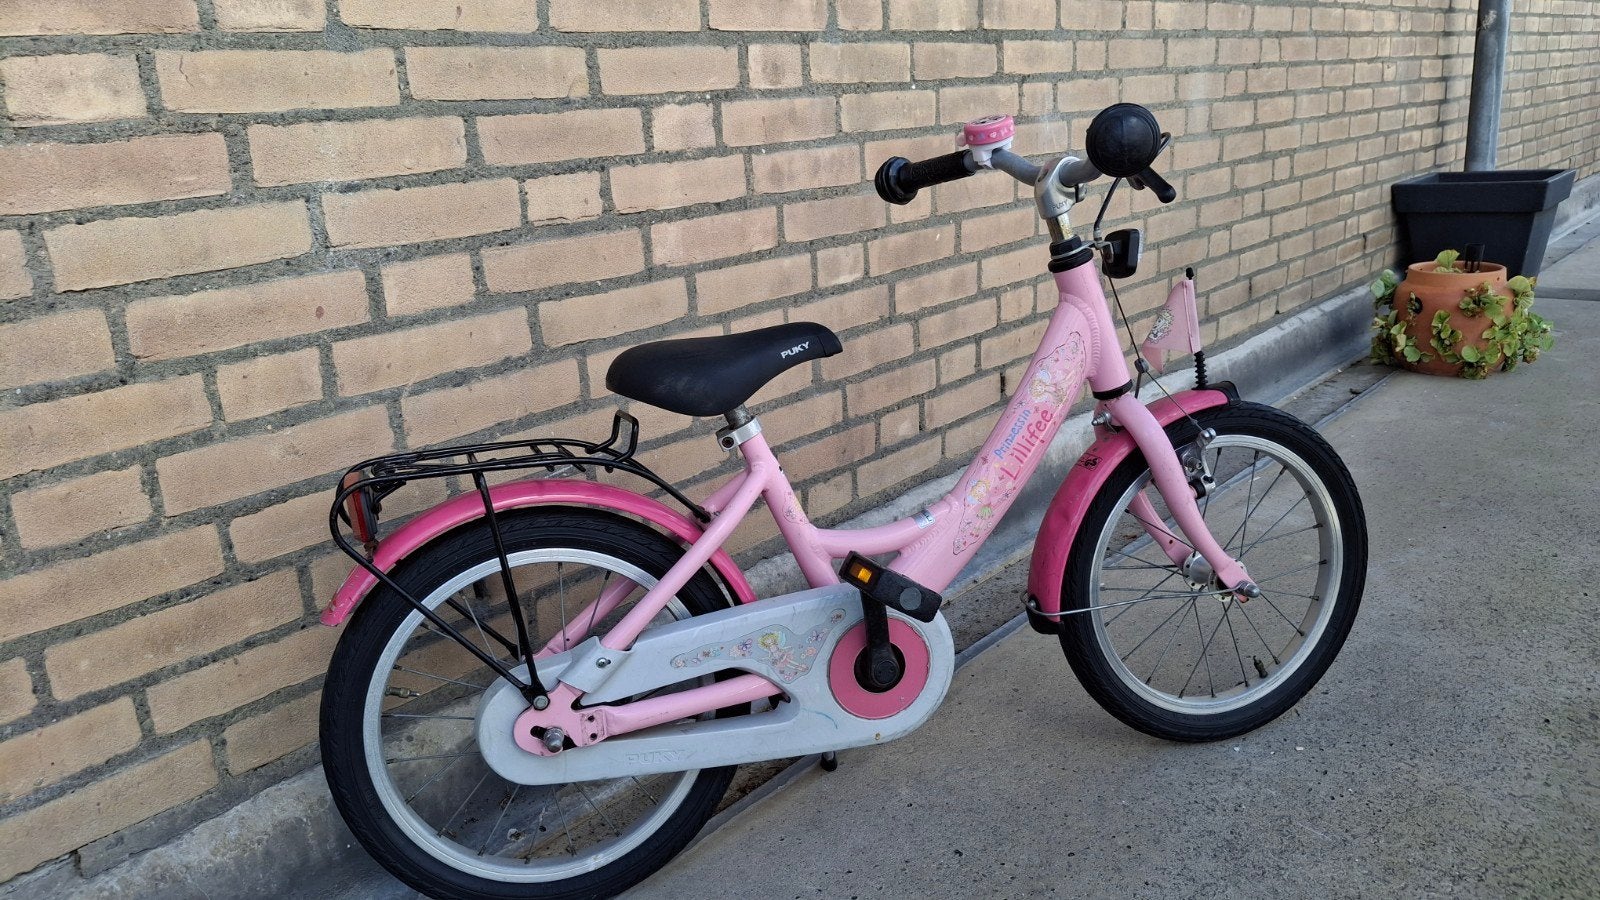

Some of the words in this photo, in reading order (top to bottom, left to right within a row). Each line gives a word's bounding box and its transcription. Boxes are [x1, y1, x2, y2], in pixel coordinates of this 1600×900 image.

[780, 341, 809, 359] PUKY
[993, 409, 1031, 460] Prinzessin
[1000, 409, 1053, 480] Lillifee
